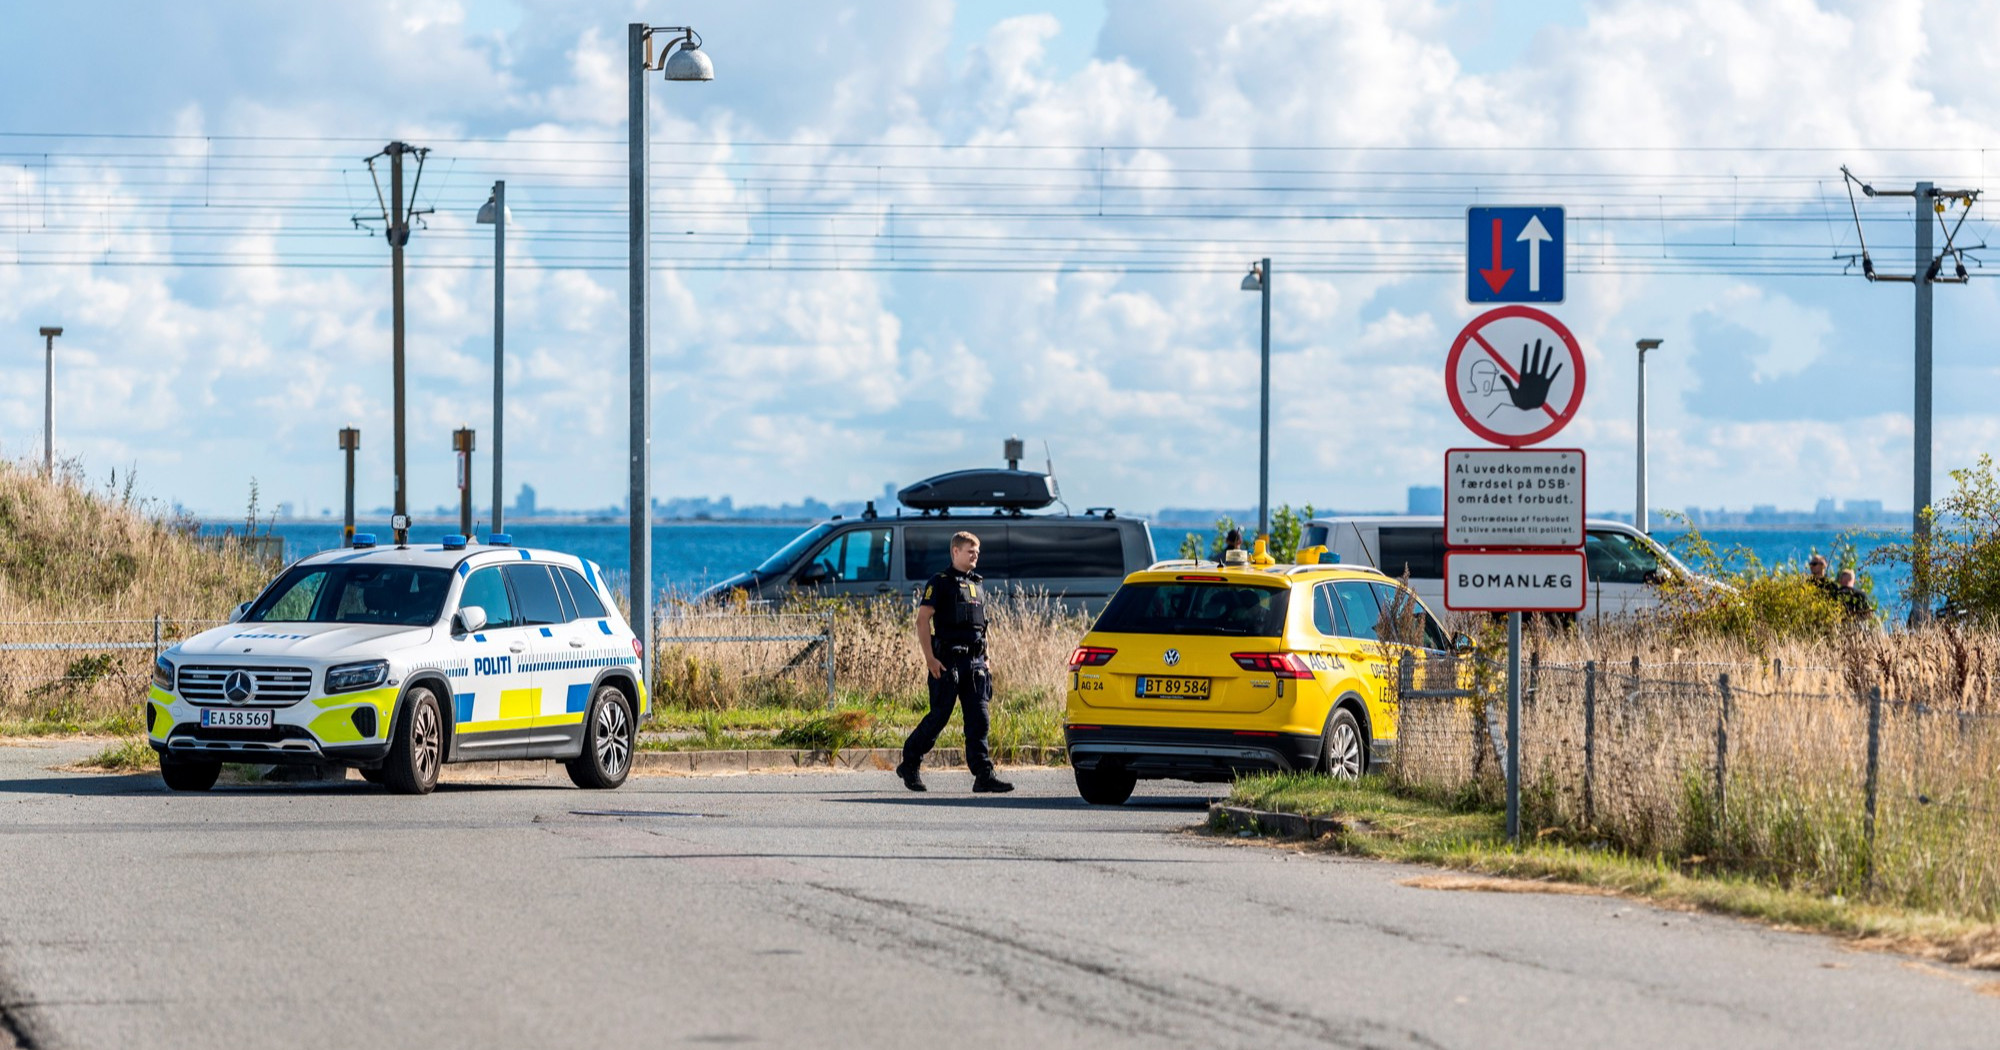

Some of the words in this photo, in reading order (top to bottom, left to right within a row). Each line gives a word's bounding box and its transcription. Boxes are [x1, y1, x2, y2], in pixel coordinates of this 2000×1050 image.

[1456, 464, 1469, 474] Al
[1474, 464, 1576, 474] uvedkommende
[1461, 479, 1513, 489] færdsel
[1517, 479, 1532, 490] på
[1538, 479, 1570, 489] DSB-
[1457, 493, 1513, 504] området
[1518, 493, 1574, 504] forbudt.
[1458, 574, 1572, 588] BOMANLÆG
[474, 655, 512, 676] POLITI
[1308, 652, 1327, 671] AG
[1327, 653, 1345, 671] 24
[1081, 681, 1091, 690] AG
[1093, 682, 1104, 691] 24
[1146, 680, 1163, 692] BT
[1165, 680, 1181, 693] 89
[1183, 680, 1207, 693] 584
[210, 712, 226, 725] EA
[229, 712, 243, 725] 58
[246, 712, 269, 726] 569
